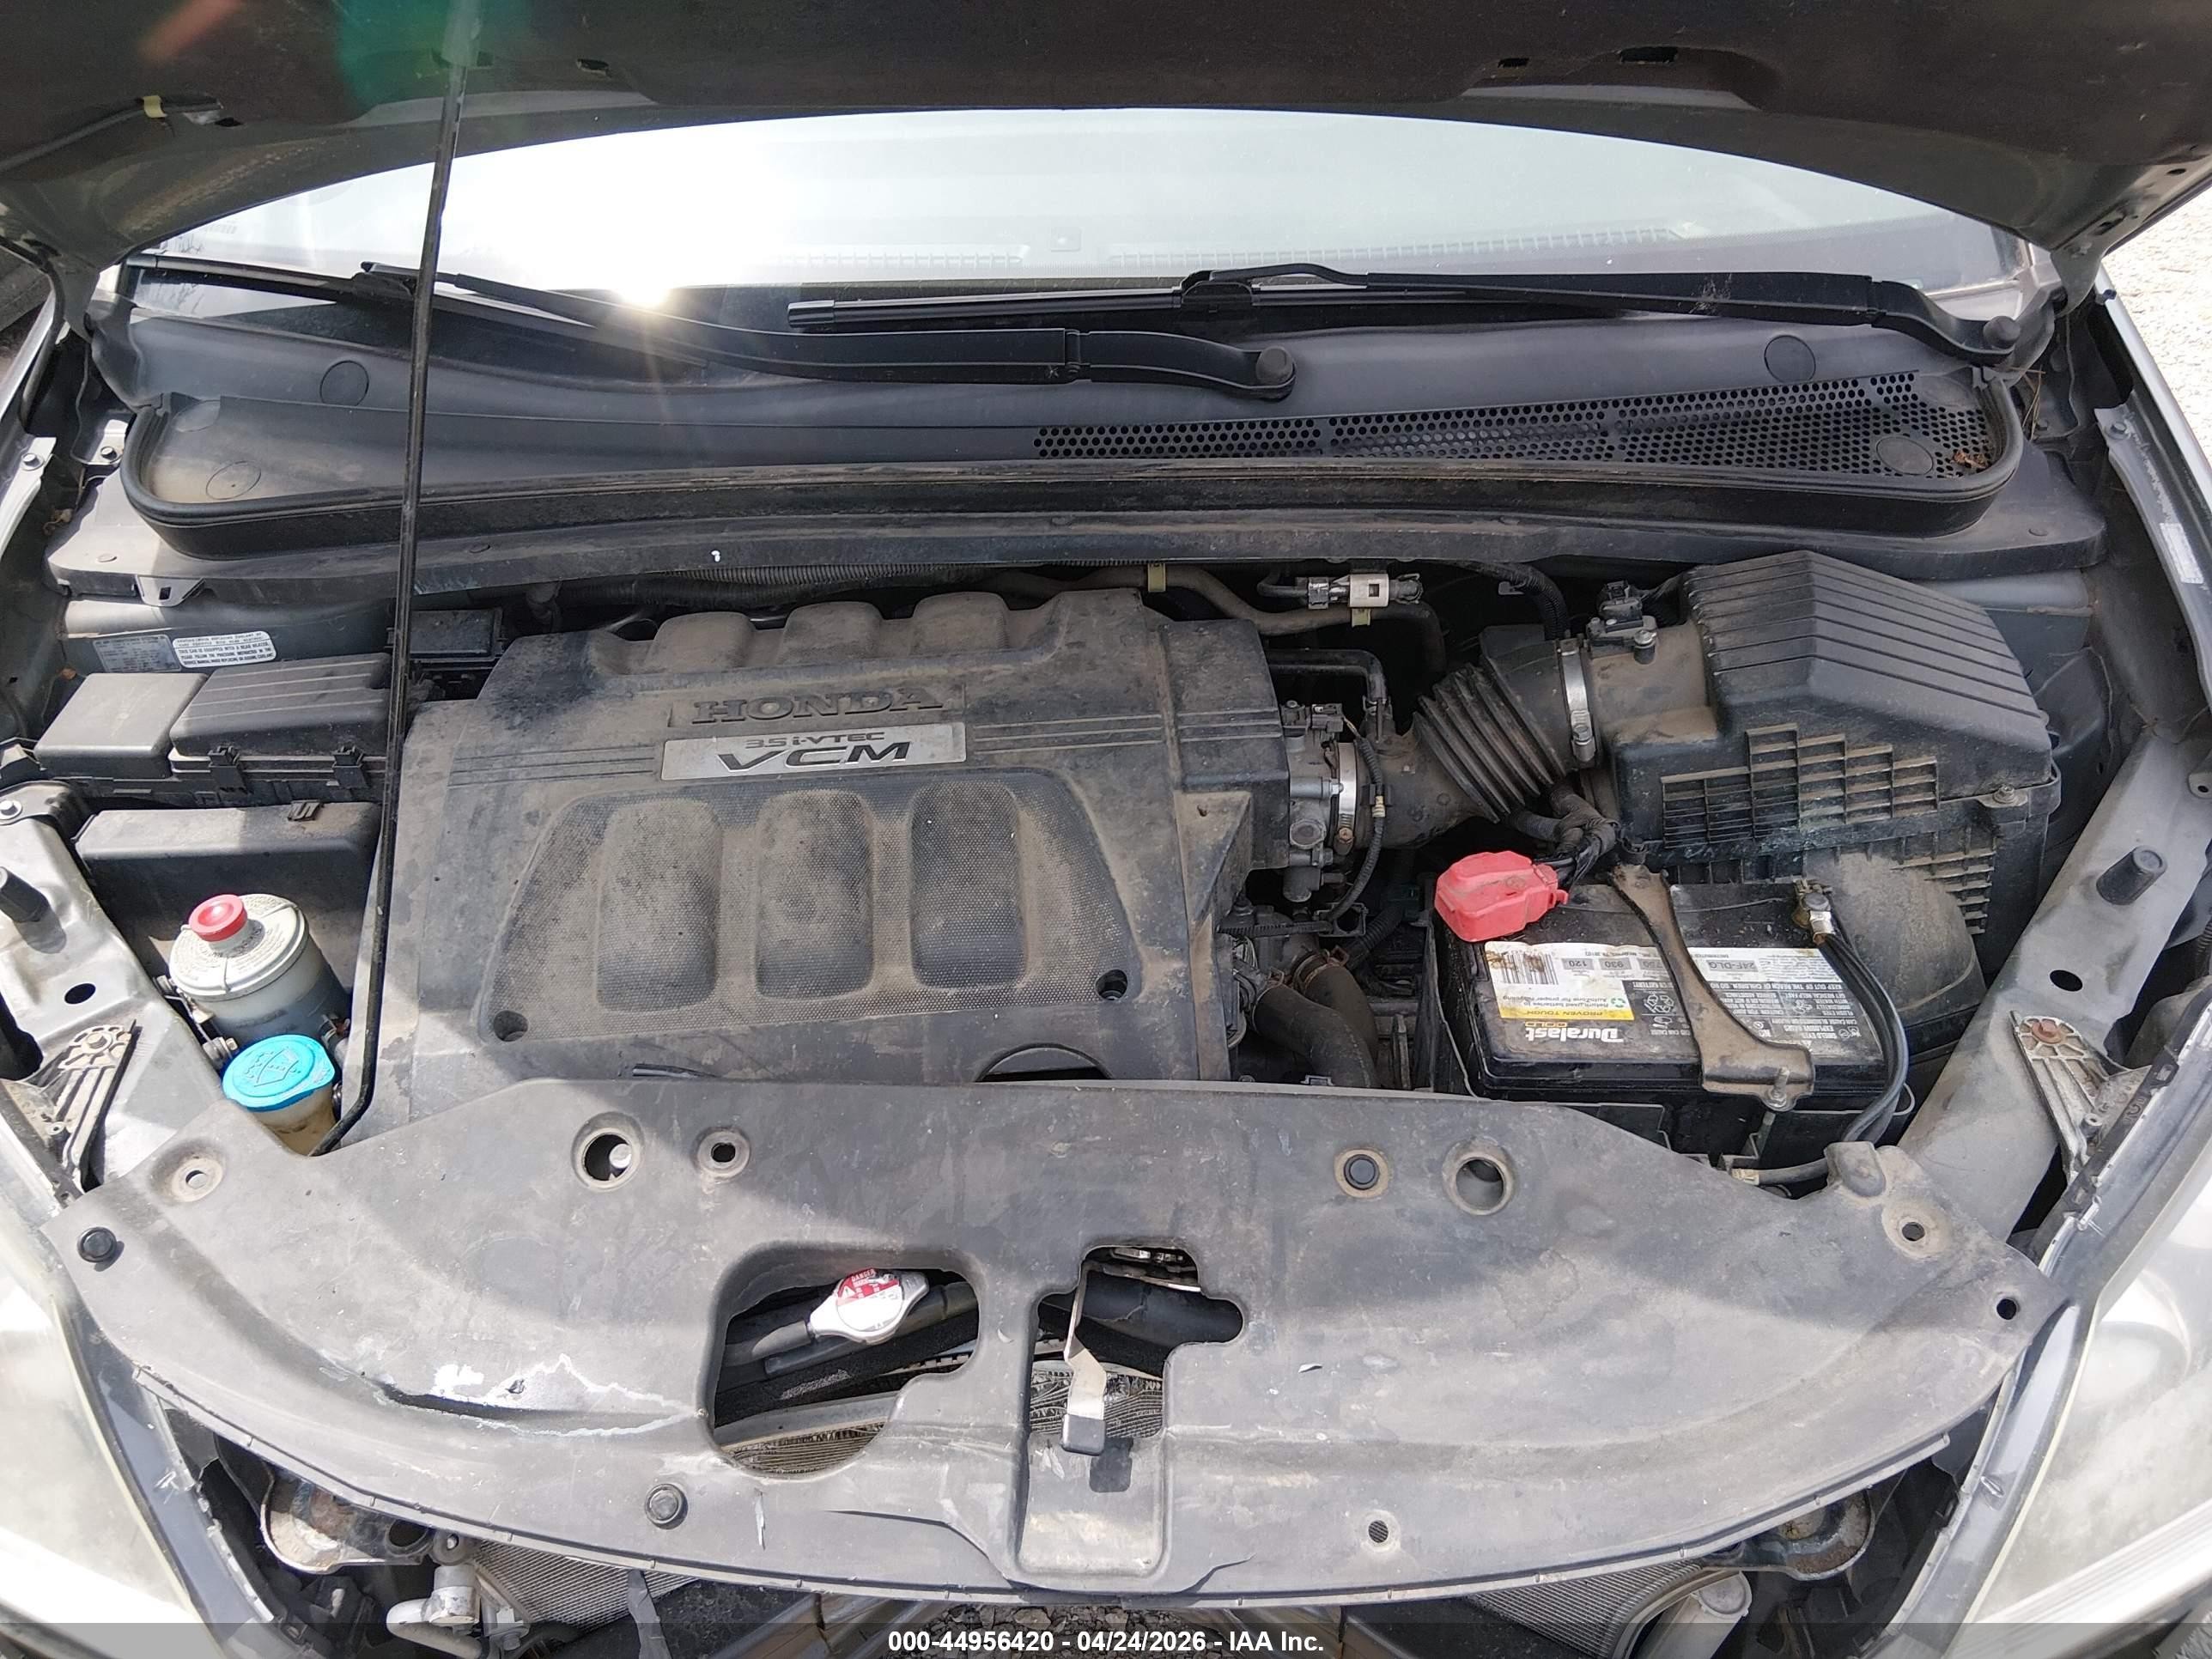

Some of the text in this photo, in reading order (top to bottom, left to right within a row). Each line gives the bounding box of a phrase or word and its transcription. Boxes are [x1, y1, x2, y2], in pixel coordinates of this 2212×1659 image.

[691, 690, 943, 724] HONDA
[717, 741, 910, 772] VCM
[1525, 1027, 1624, 1042] Duralast
[851, 1268, 877, 1281] DANGER
